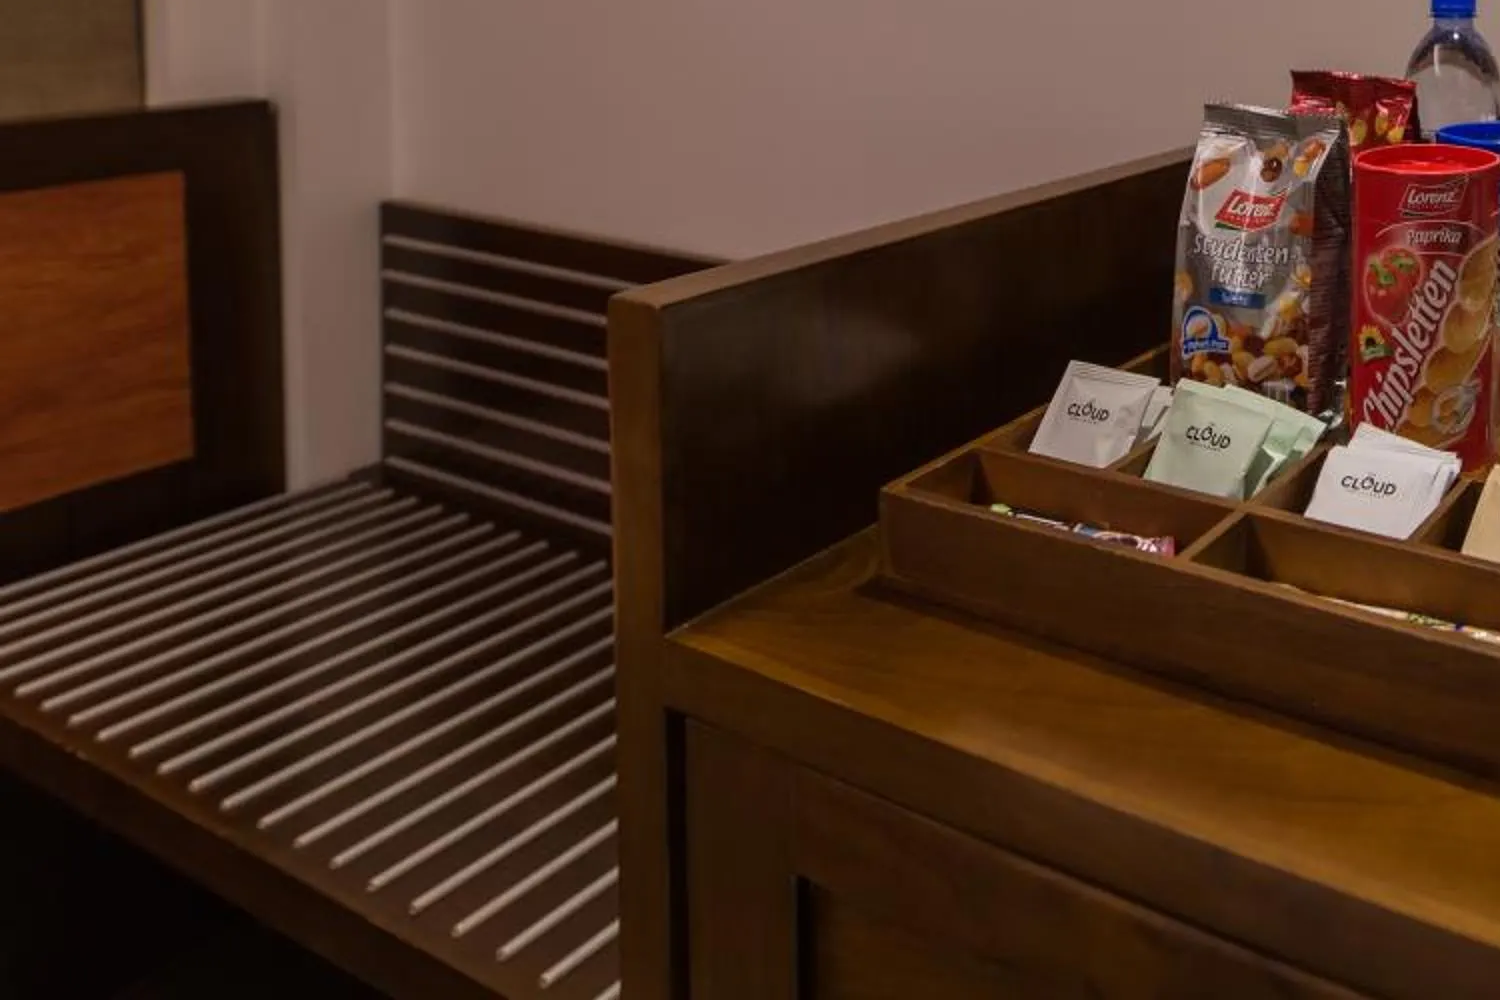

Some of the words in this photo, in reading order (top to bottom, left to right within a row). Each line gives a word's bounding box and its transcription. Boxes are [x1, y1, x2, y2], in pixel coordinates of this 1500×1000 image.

[1227, 194, 1275, 217] Lorenz
[1407, 187, 1456, 205] Lorenz
[1407, 226, 1463, 246] Paprika
[1067, 401, 1110, 422] CLOUD
[1186, 425, 1231, 449] CLOUD
[1340, 474, 1397, 496] CLOUD
